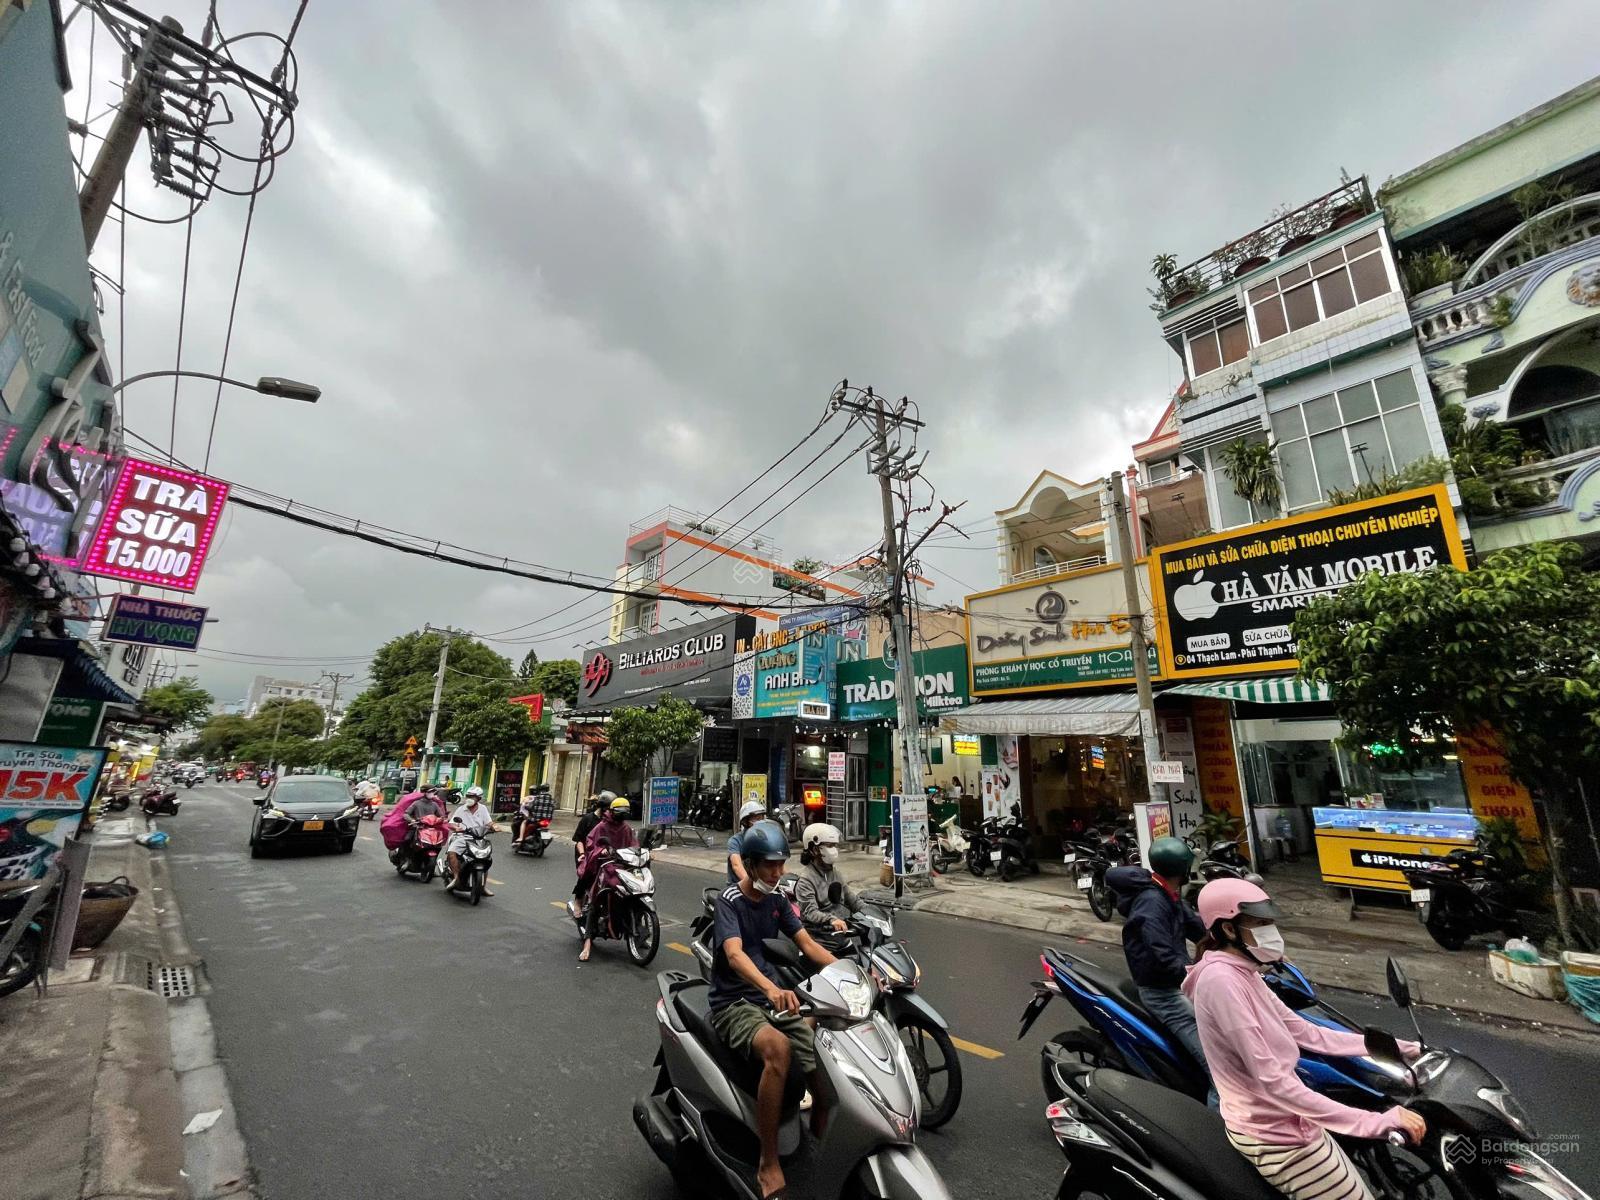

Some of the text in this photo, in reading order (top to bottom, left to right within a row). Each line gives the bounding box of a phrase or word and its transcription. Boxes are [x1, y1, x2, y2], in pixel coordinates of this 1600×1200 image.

[133, 474, 208, 516] TRÀ
[116, 506, 196, 548] SỮA
[1165, 559, 1185, 575] MUA
[1186, 553, 1206, 571] BÁN
[1206, 549, 1219, 567] VÀ
[1241, 539, 1270, 560] CHỮA
[1270, 534, 1297, 556] ĐIỆN
[1298, 528, 1335, 548] THOẠI
[1335, 515, 1388, 541] CHUYÊN
[1388, 505, 1439, 529] NGHIỆP
[104, 537, 192, 578] 15.000
[1220, 545, 1439, 603] HÀ VĂN MOBILE
[119, 599, 203, 622] NHÀ THUỐC
[144, 620, 198, 643] VỌNG
[1190, 637, 1228, 649] MUA BÁN
[1264, 628, 1290, 641] CHỮA
[618, 643, 682, 670] BILLIARDS
[684, 633, 725, 657] CLUB
[1186, 654, 1196, 665] 04
[1197, 653, 1220, 667] Thạch
[1220, 651, 1237, 661] Lam
[1241, 647, 1257, 658] Phú
[1258, 644, 1283, 660] Thạnh
[975, 667, 1000, 677] PHÒNG
[1001, 663, 1023, 674] KHÁM
[1029, 661, 1046, 671] HỌC
[1062, 654, 1093, 667] TRUYỀN
[765, 673, 789, 690] ANH
[0, 769, 89, 801] 15K
[1173, 789, 1198, 805] Sinh
[1373, 854, 1431, 871] iPhone
